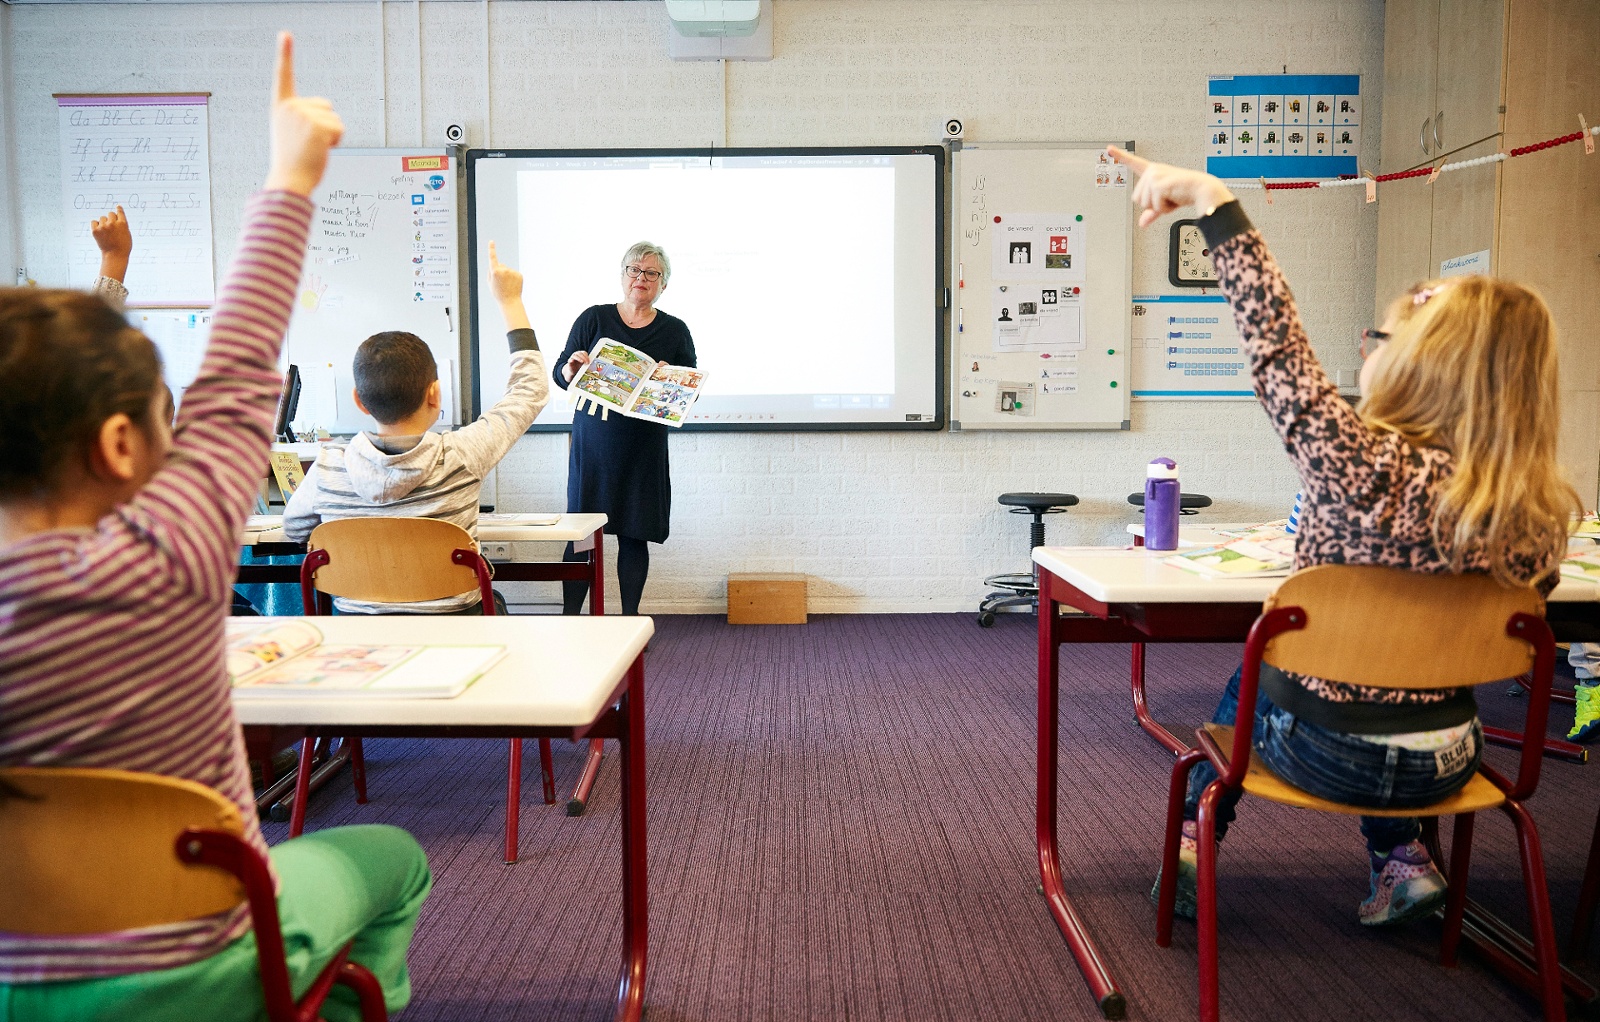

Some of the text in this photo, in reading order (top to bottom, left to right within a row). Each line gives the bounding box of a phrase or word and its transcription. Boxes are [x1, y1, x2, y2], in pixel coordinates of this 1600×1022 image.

[70, 109, 199, 126] Aa Bb Cc Dd Ee
[101, 138, 119, 161] Gg
[76, 166, 96, 182] Kk
[136, 165, 166, 181] Mm
[179, 165, 199, 181] Nn
[74, 194, 91, 209] Oo
[1440, 738, 1468, 766] BLUE
